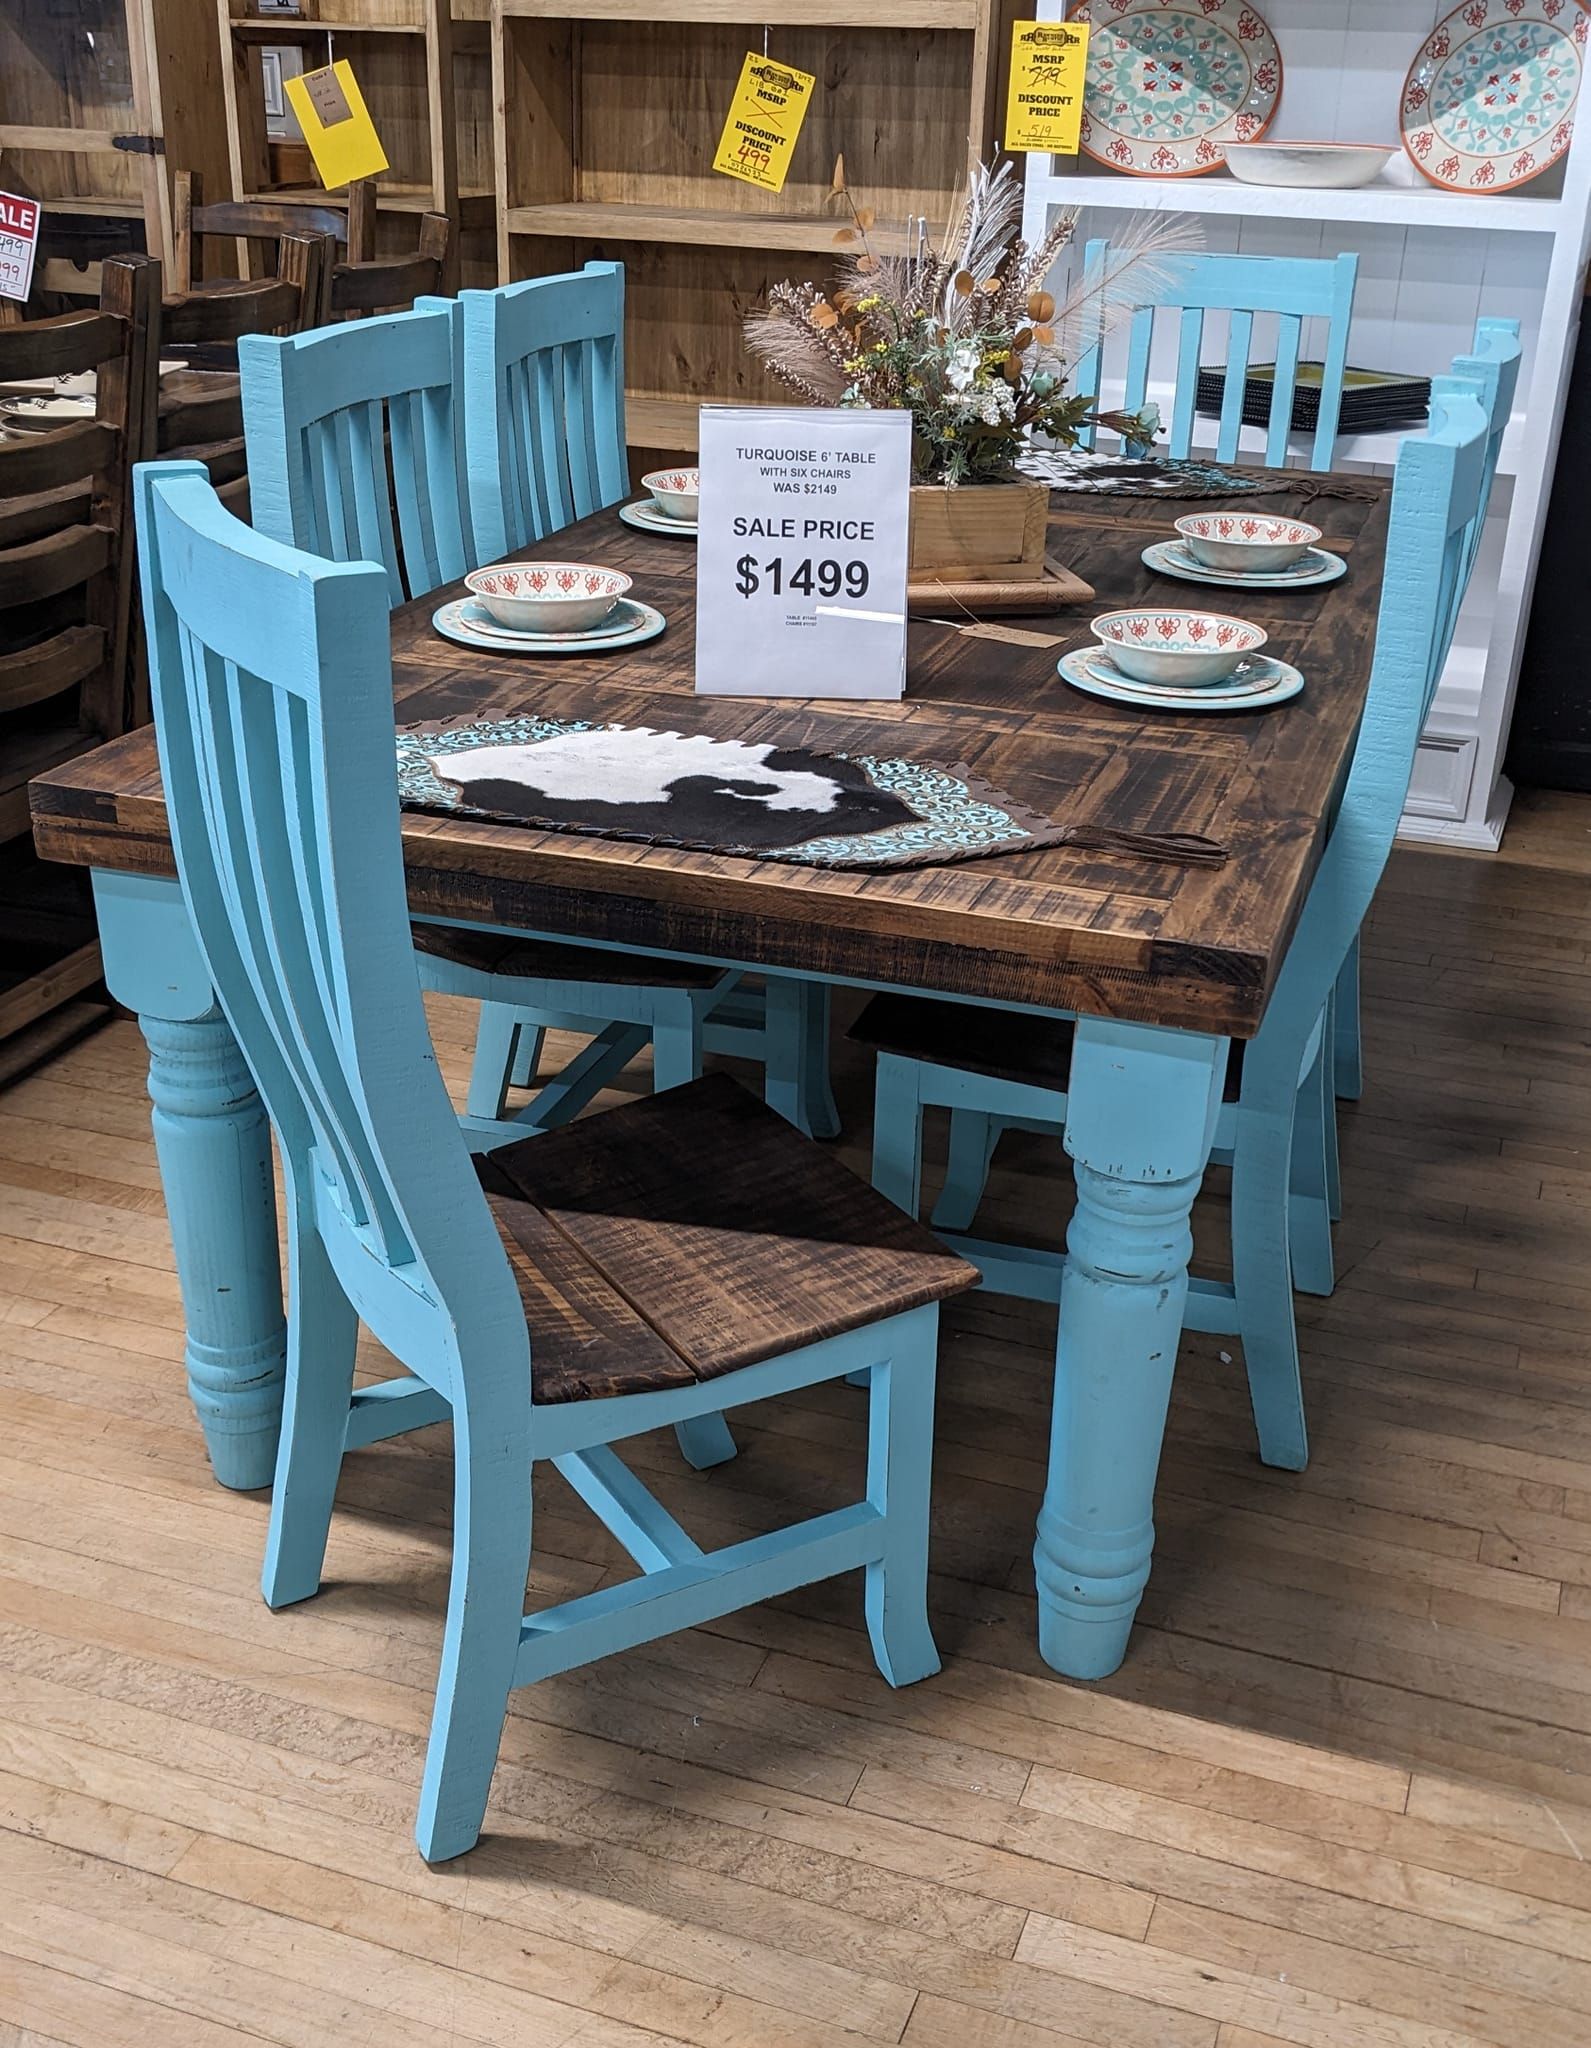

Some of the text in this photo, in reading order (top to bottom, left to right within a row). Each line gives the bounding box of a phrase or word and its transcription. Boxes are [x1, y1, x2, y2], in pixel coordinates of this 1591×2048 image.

[1032, 54, 1065, 64] MSRP
[756, 89, 787, 106] MSRP
[1018, 94, 1073, 105] DISCOUNT
[1029, 107, 1060, 117] PRICE
[735, 120, 787, 146] DISCOUNT
[742, 136, 773, 153] PRICE
[738, 145, 770, 172] 499
[0, 261, 20, 281] 99
[736, 448, 876, 464] TURQUOISE 6' TABLE
[760, 467, 851, 479] WITH SIX CHAIRS
[773, 482, 837, 495] WAS $2149
[733, 517, 875, 541] SALE PRICE
[735, 554, 869, 599] $1499
